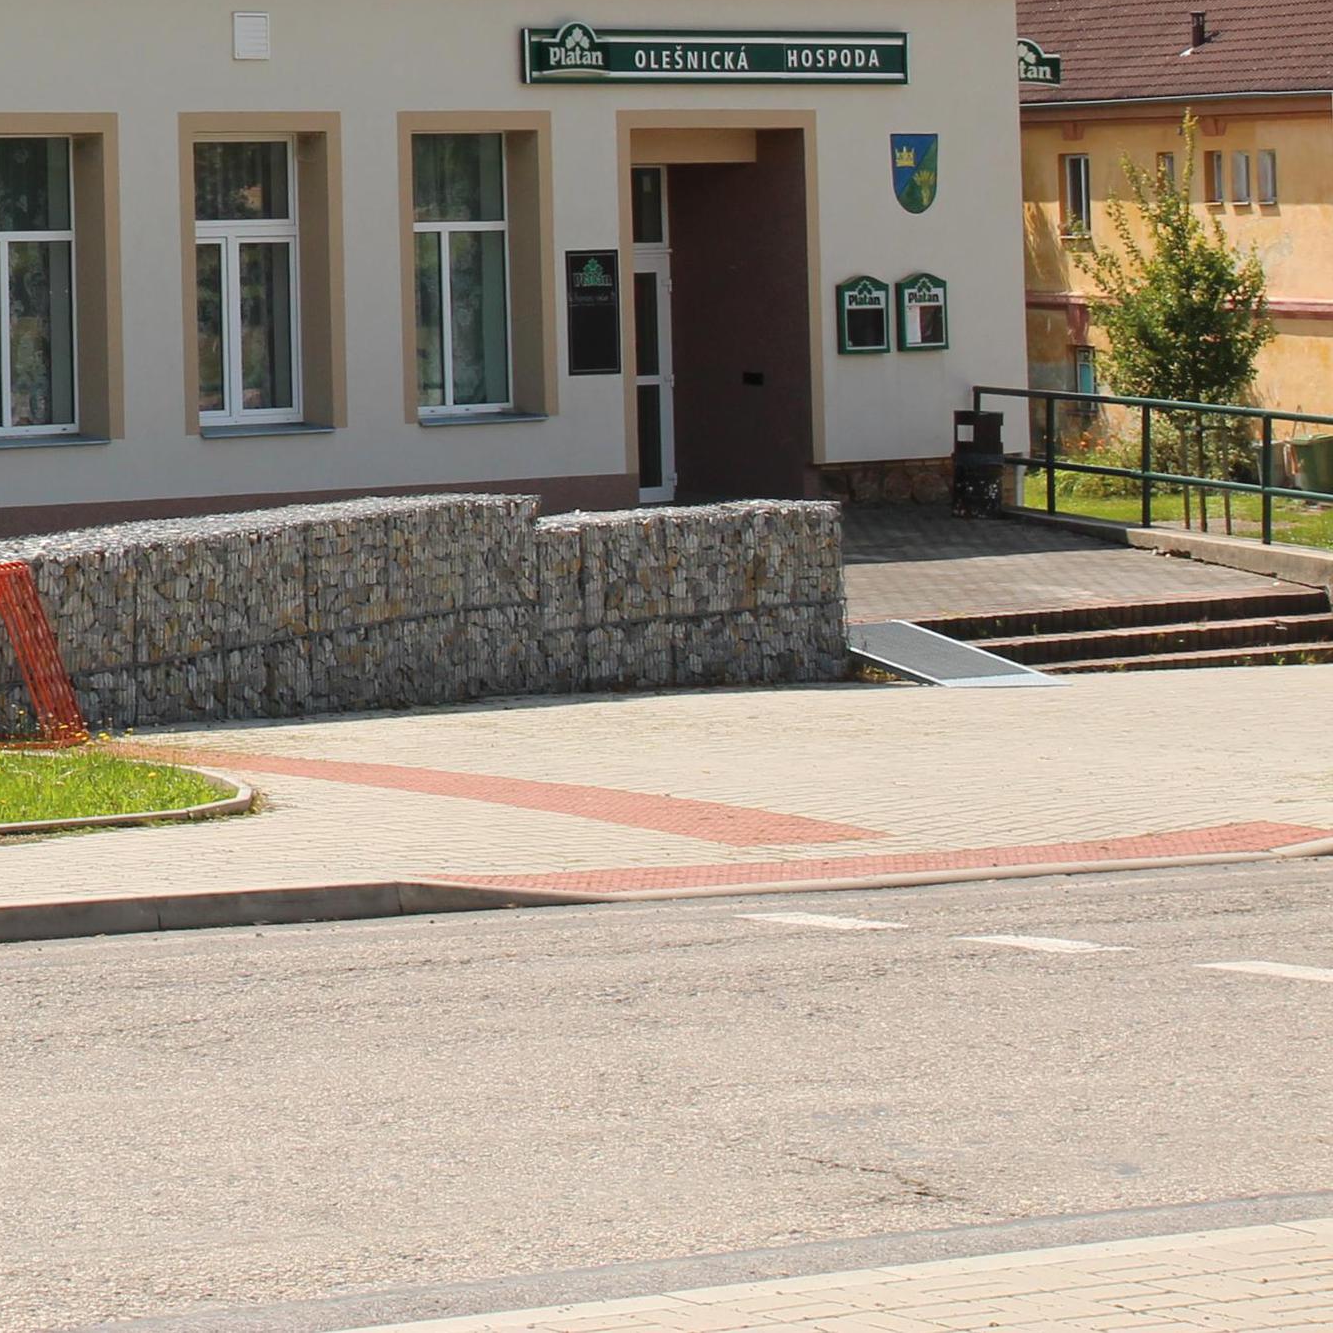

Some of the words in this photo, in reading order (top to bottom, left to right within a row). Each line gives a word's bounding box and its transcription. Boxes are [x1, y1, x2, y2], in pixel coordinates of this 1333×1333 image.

[549, 46, 604, 66] Platan
[634, 46, 749, 70] OLEŠNICKÁ
[787, 48, 880, 68] HOSPODA
[848, 294, 880, 305] Platan
[908, 292, 939, 303] Platan
